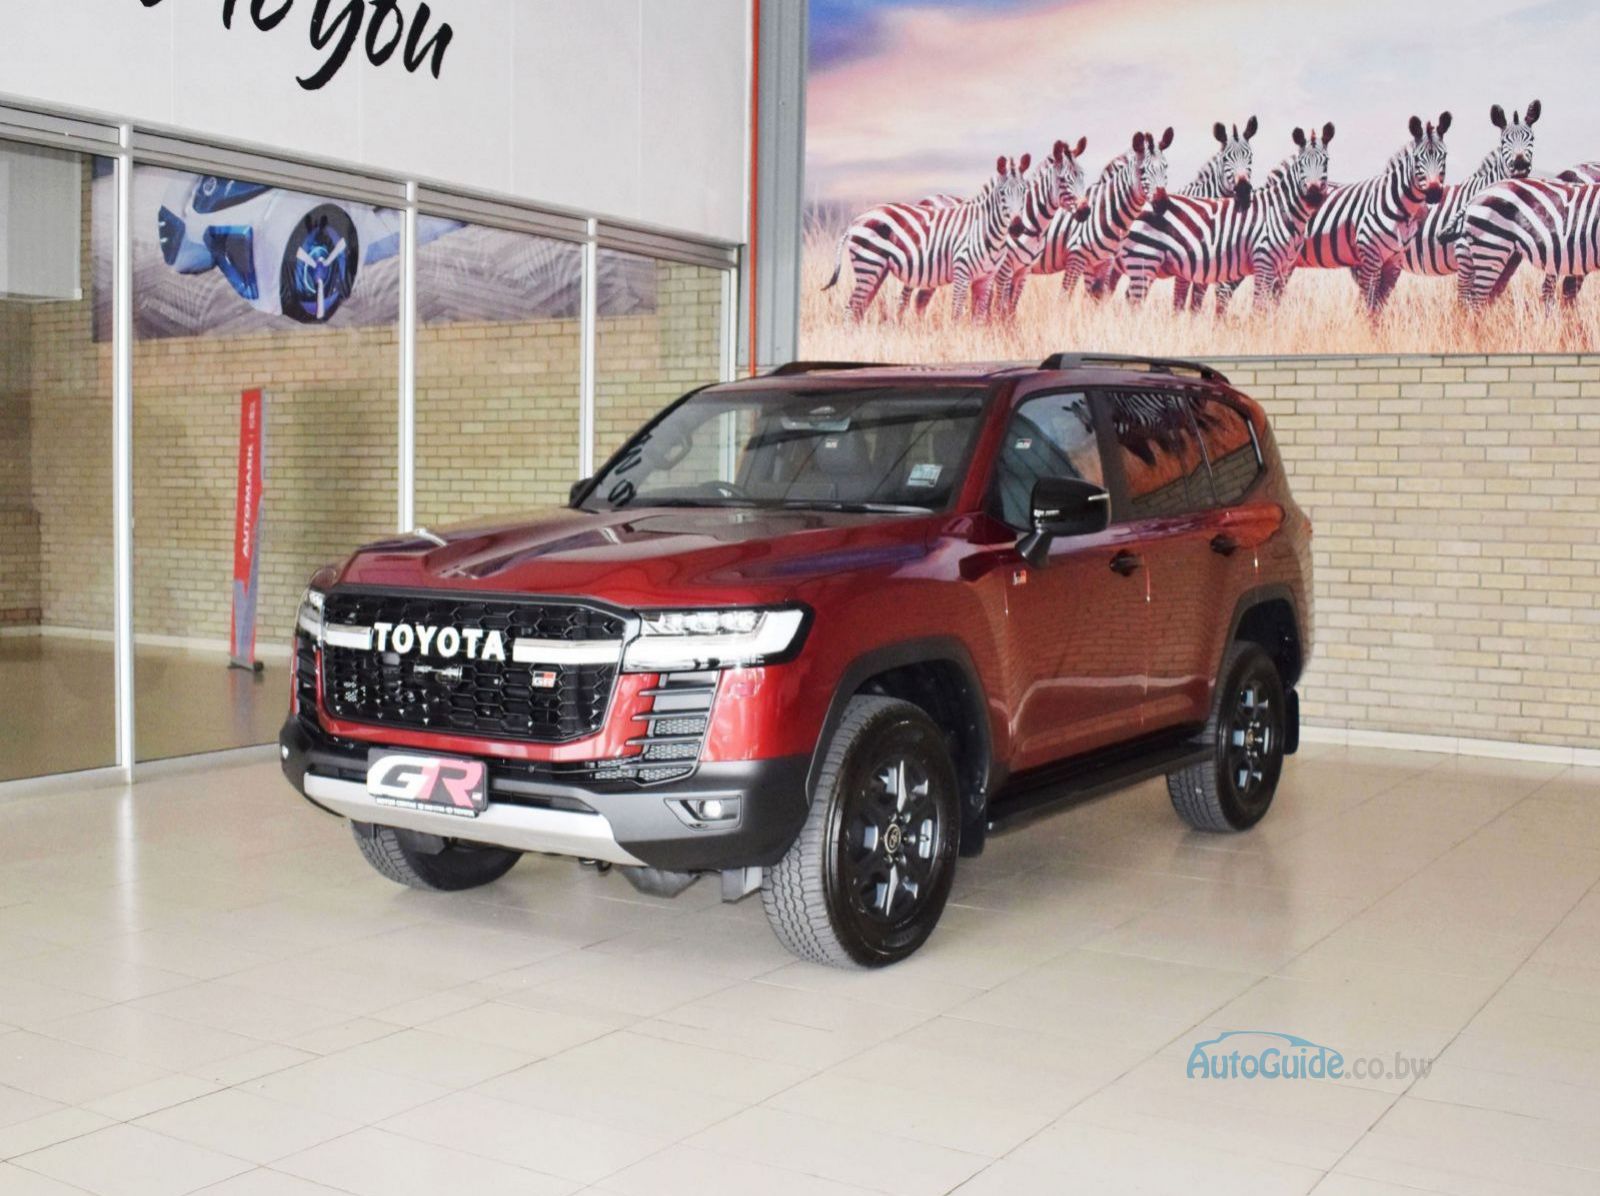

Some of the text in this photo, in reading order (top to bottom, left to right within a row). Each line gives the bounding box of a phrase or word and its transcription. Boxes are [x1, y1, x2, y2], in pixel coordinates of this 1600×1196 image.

[295, 0, 453, 91] you
[374, 622, 506, 661] TOYOTA
[367, 755, 483, 808] GR
